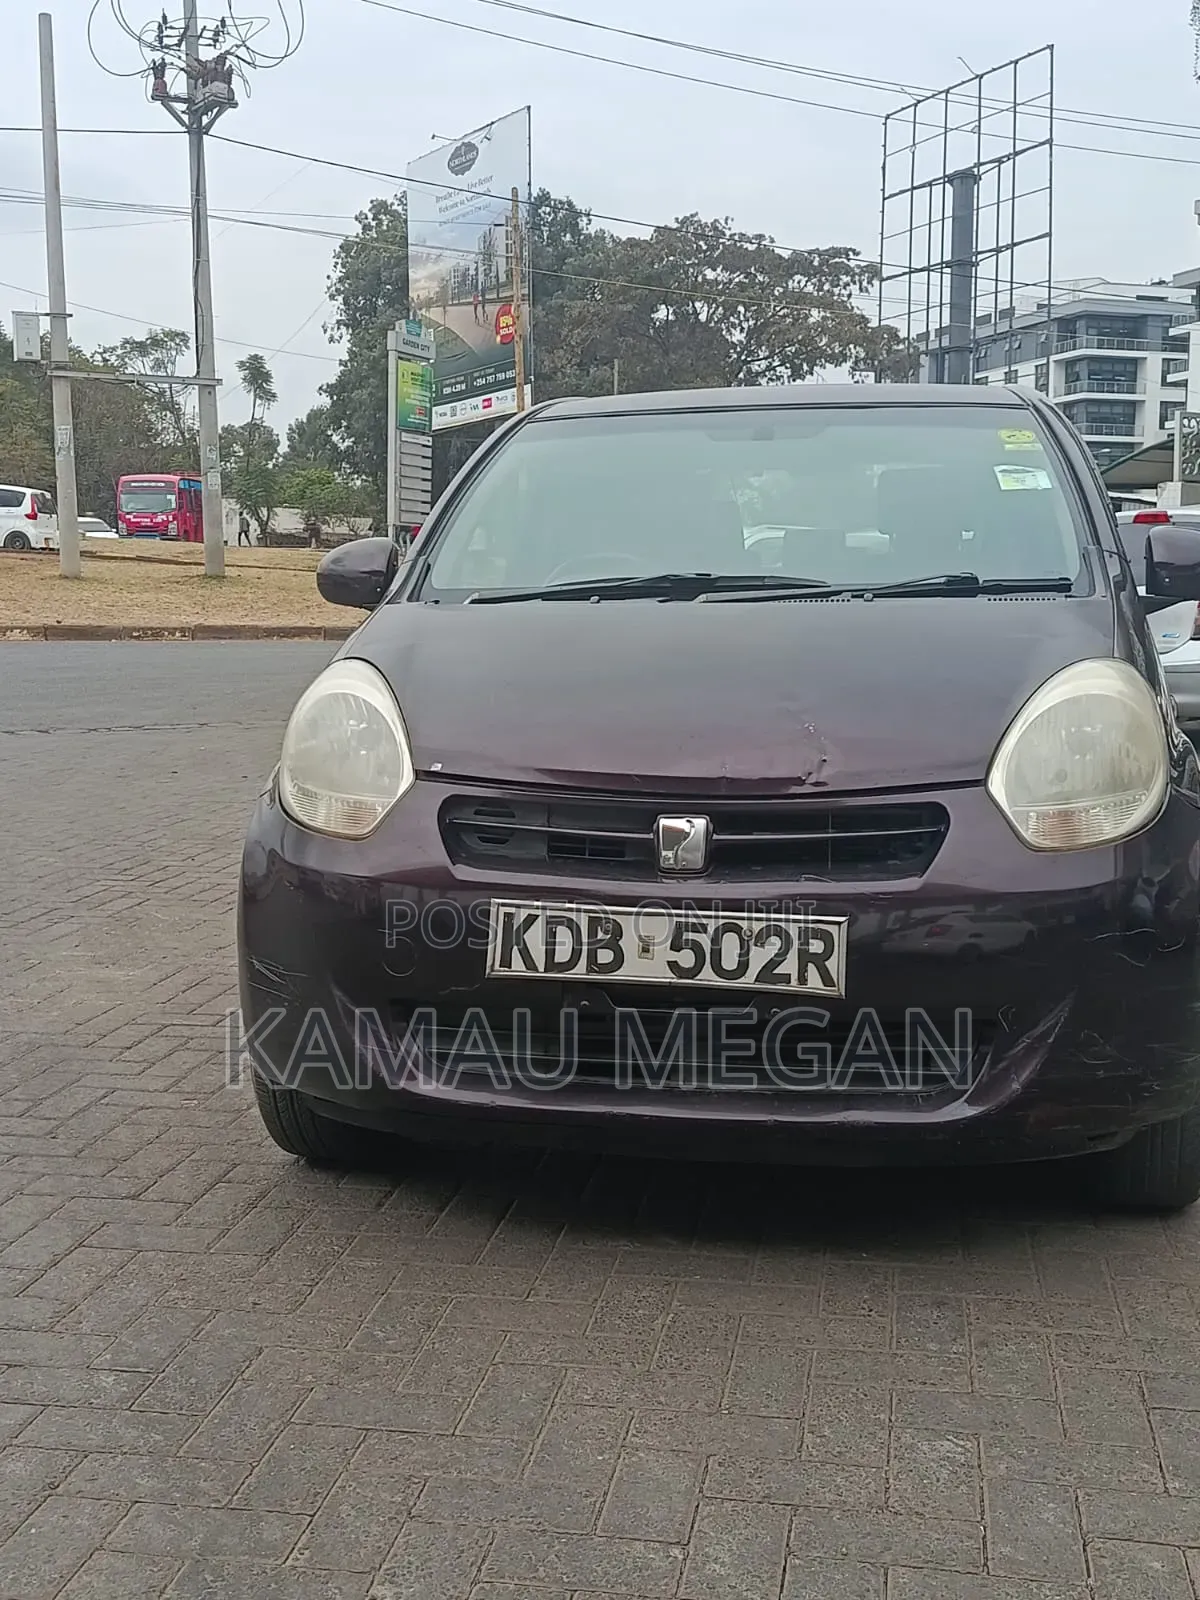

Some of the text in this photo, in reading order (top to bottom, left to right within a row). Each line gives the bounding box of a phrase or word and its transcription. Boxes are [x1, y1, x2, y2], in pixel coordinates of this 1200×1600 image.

[499, 326, 513, 335] SOLD
[402, 338, 430, 352] GARDEN CITY
[499, 911, 837, 988] KDB 502R
